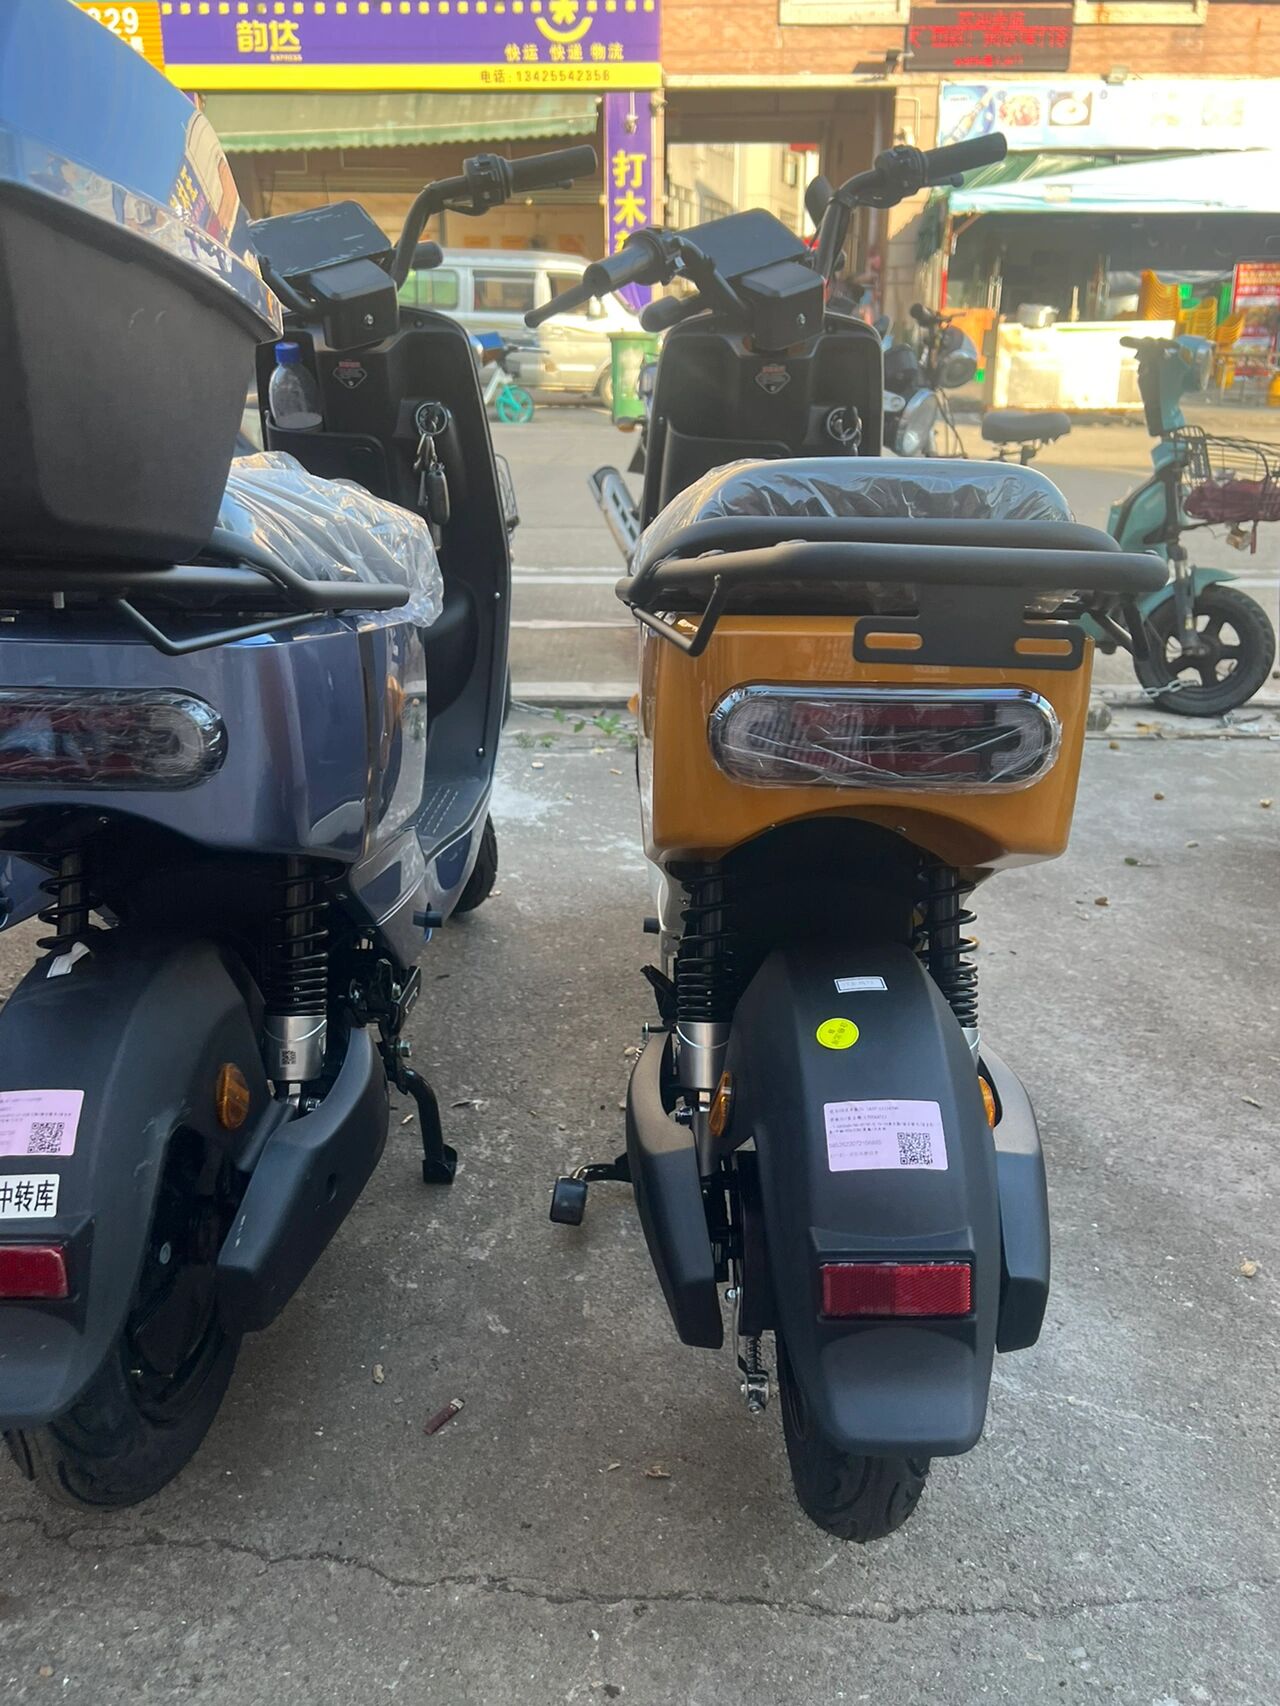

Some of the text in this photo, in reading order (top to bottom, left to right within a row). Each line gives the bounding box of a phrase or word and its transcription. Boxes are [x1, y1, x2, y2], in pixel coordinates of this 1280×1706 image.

[236, 19, 302, 53] 韵达
[504, 41, 624, 62] 快运 快递 物流
[0, 1180, 55, 1213] 中转库
